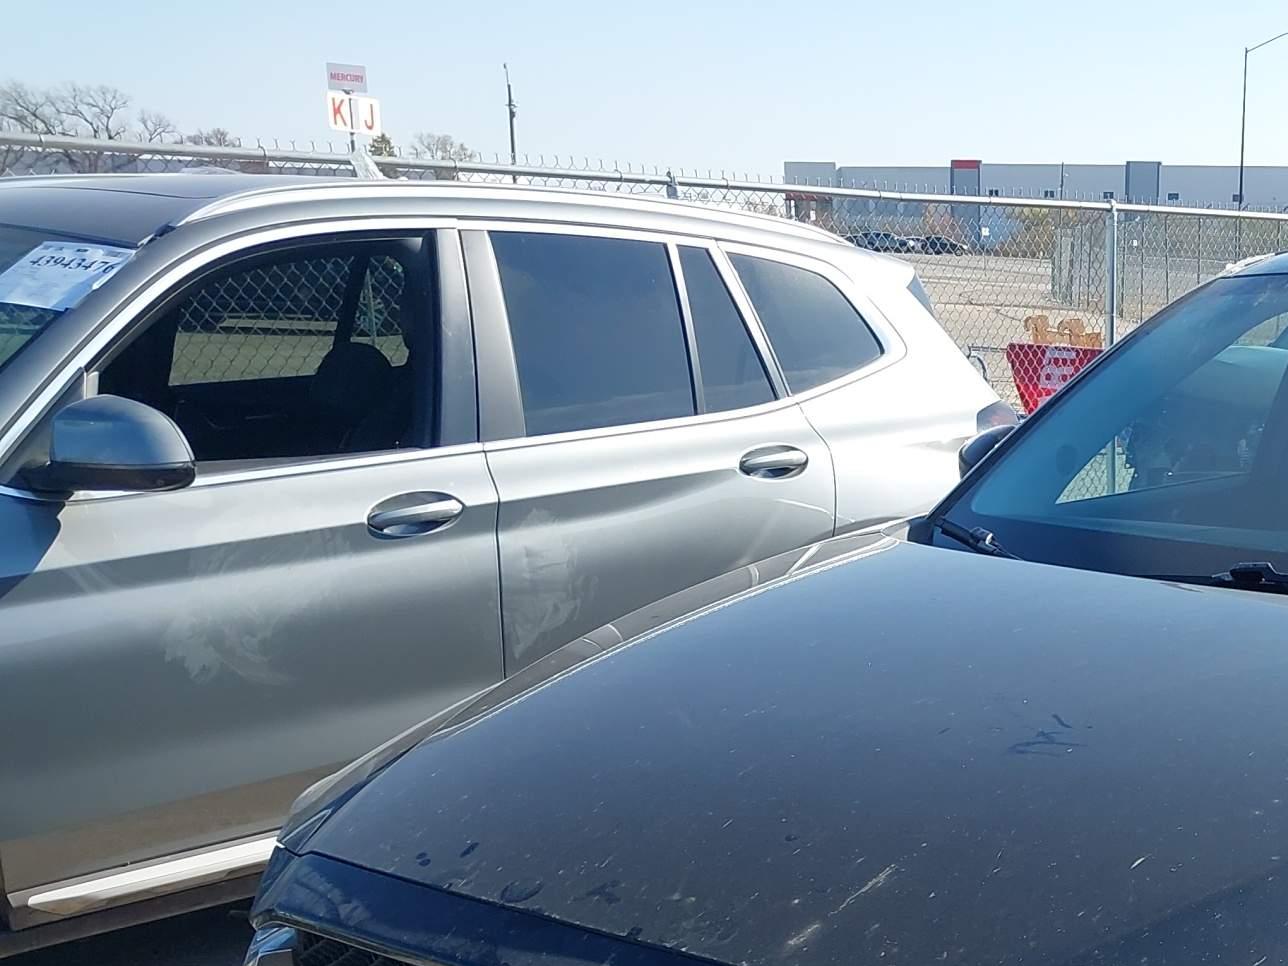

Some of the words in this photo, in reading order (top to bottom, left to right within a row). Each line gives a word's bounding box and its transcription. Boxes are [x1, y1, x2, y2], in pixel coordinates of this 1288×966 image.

[330, 71, 364, 84] MERCURY
[331, 97, 348, 127] K
[364, 103, 375, 131] J
[29, 254, 121, 274] 43943476
